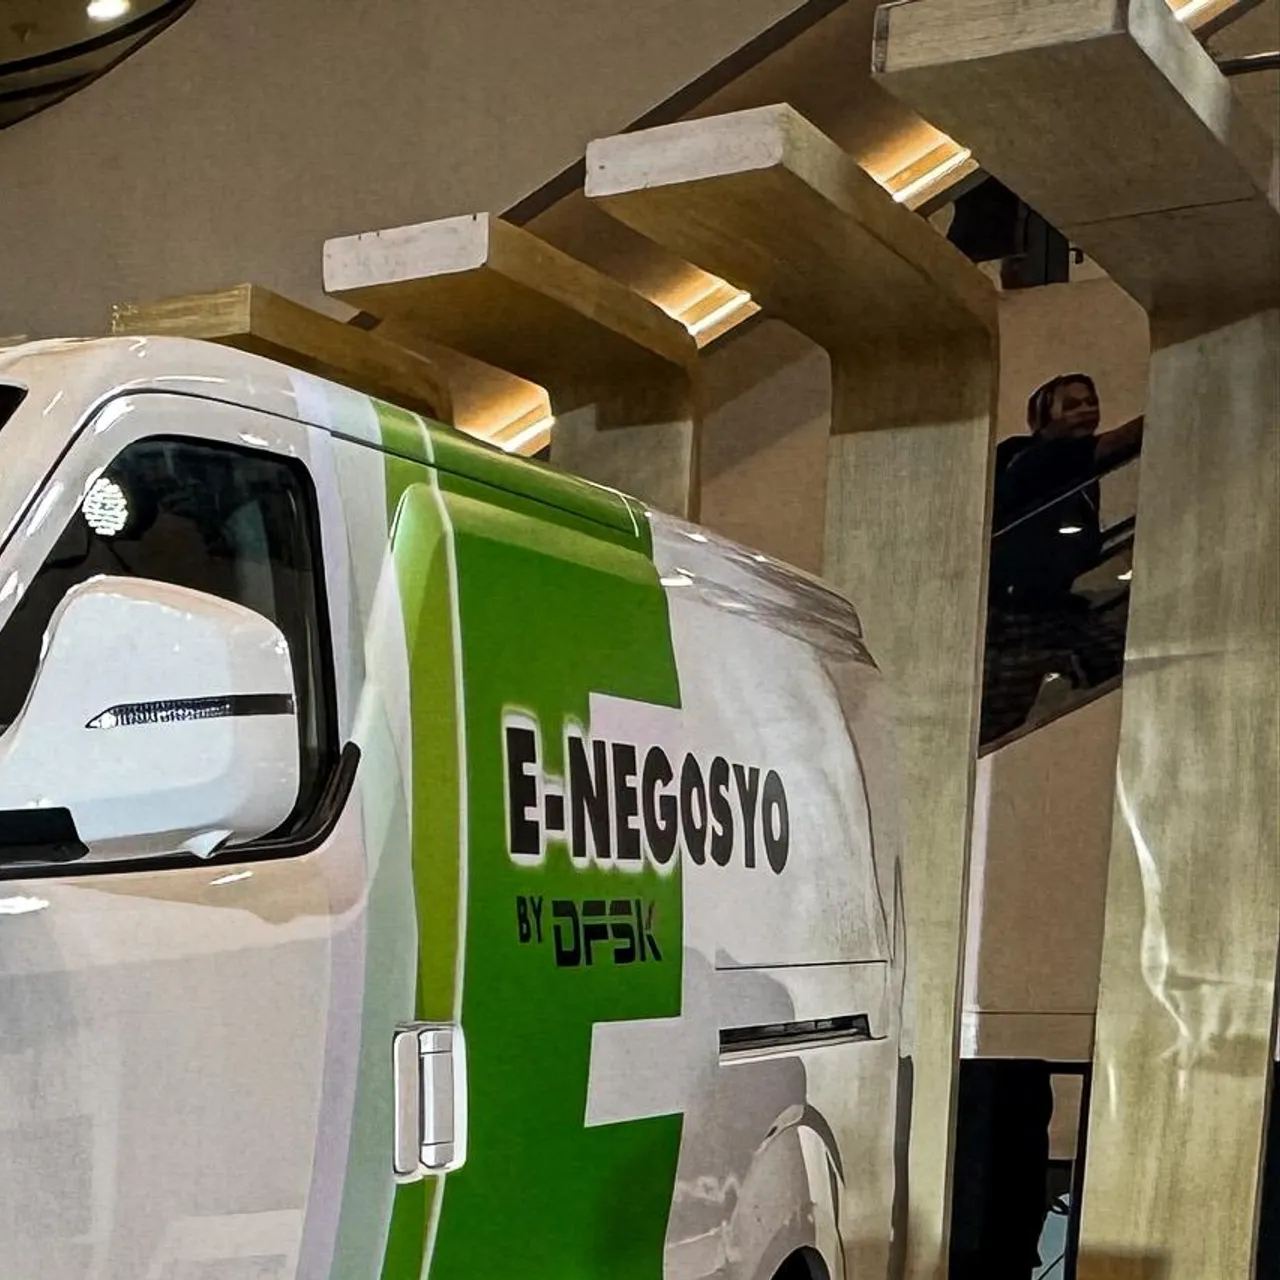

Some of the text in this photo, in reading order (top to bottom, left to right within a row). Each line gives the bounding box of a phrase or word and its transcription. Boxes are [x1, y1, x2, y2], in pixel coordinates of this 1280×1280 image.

[505, 726, 789, 875] E-NEGOSYO
[516, 896, 662, 966] BY DFSK
